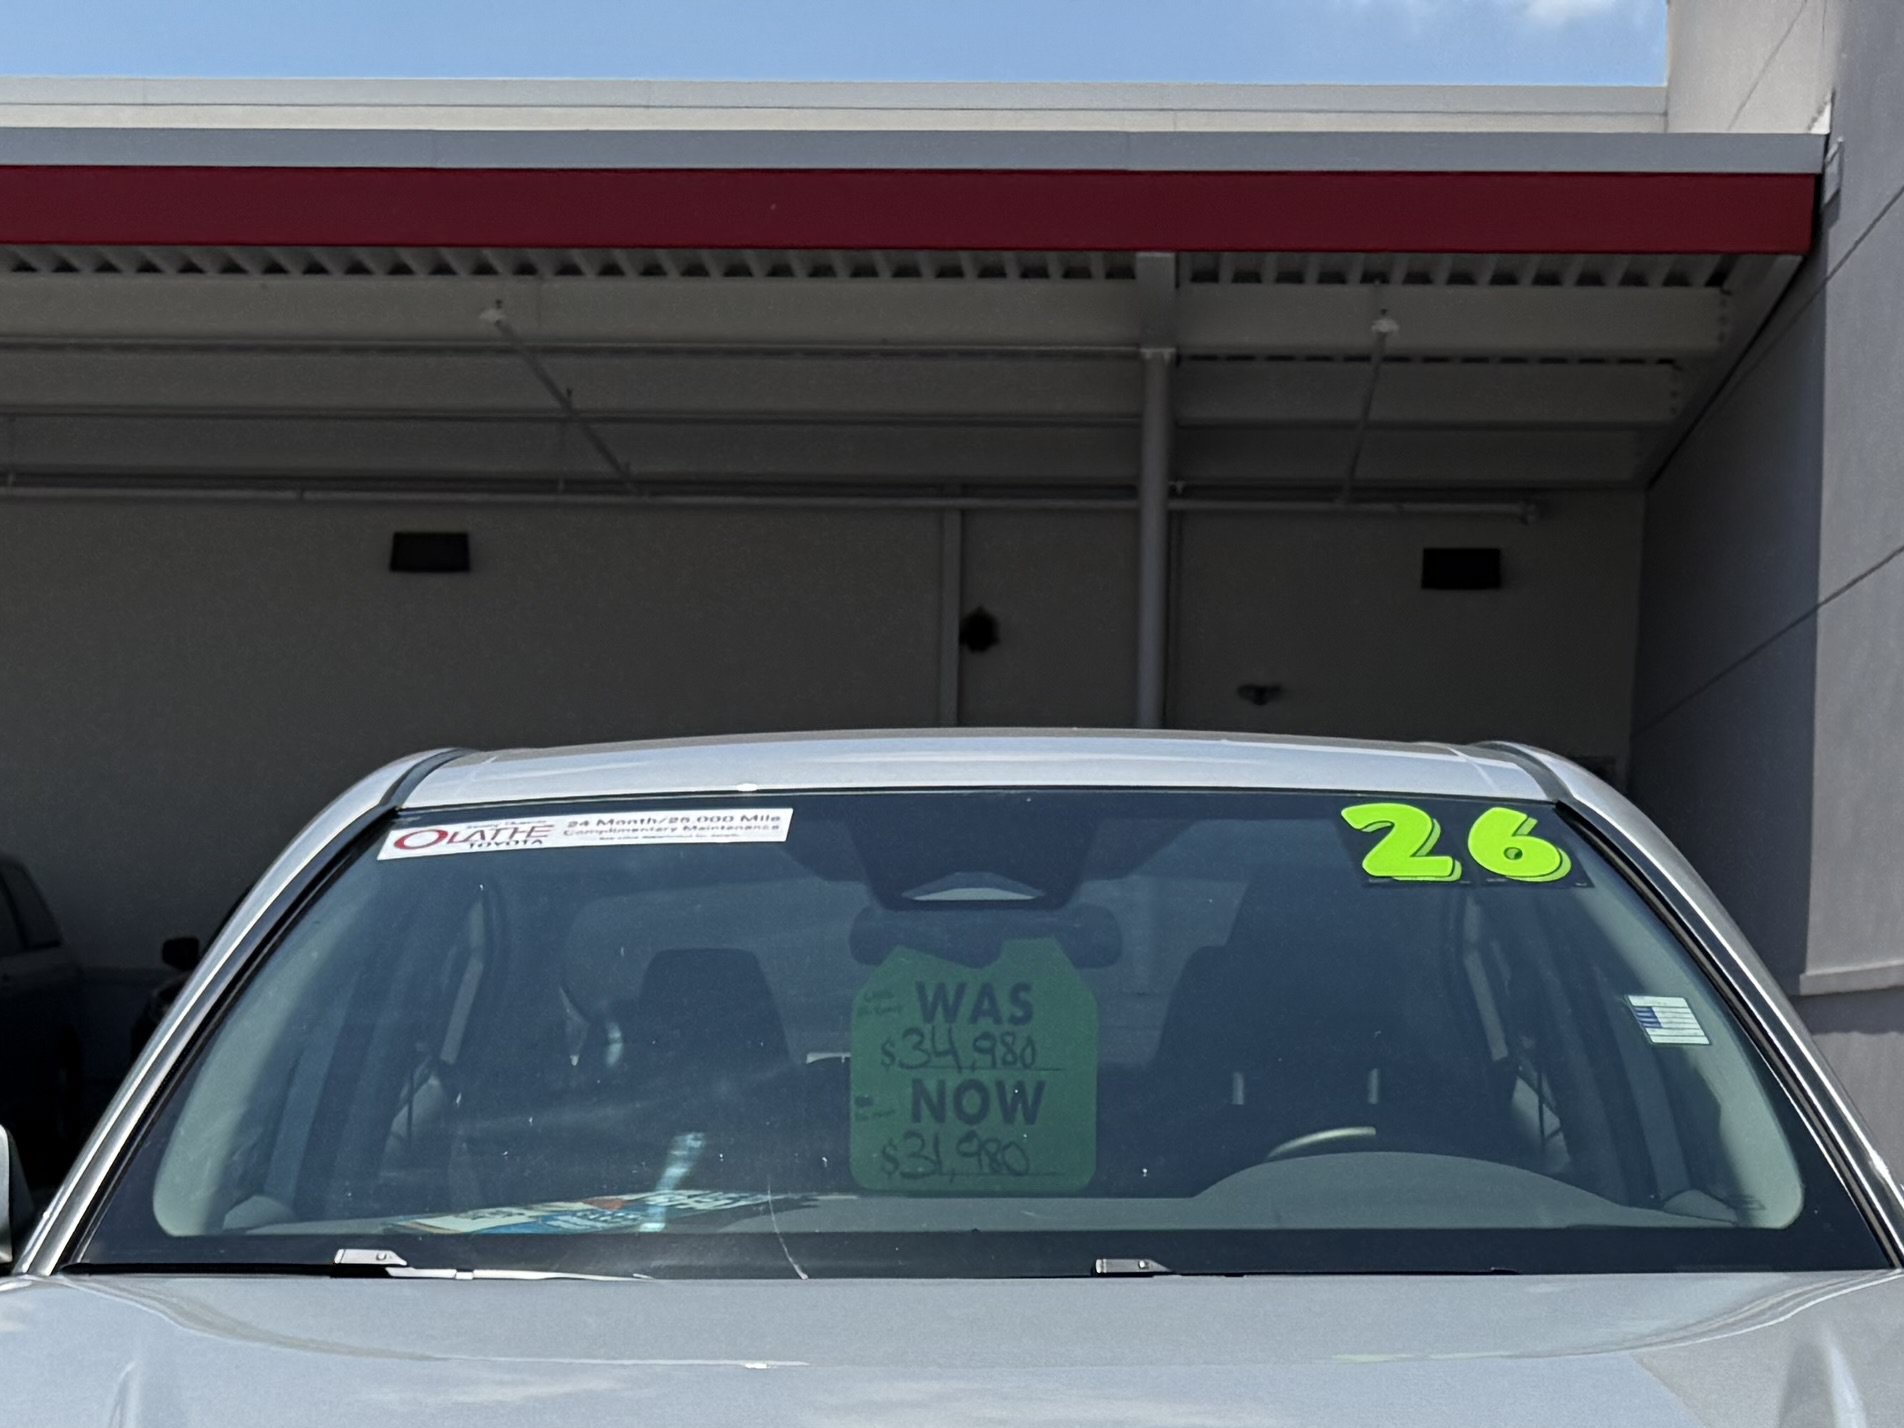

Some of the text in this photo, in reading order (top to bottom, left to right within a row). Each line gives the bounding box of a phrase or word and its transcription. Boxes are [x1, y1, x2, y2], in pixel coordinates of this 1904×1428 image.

[740, 814, 782, 822] Mile
[393, 823, 555, 850] OLATHE
[469, 839, 544, 849] TOYOTA
[1341, 802, 1572, 882] 26
[915, 980, 1035, 1026] WAS
[911, 1078, 1046, 1126] NOW
